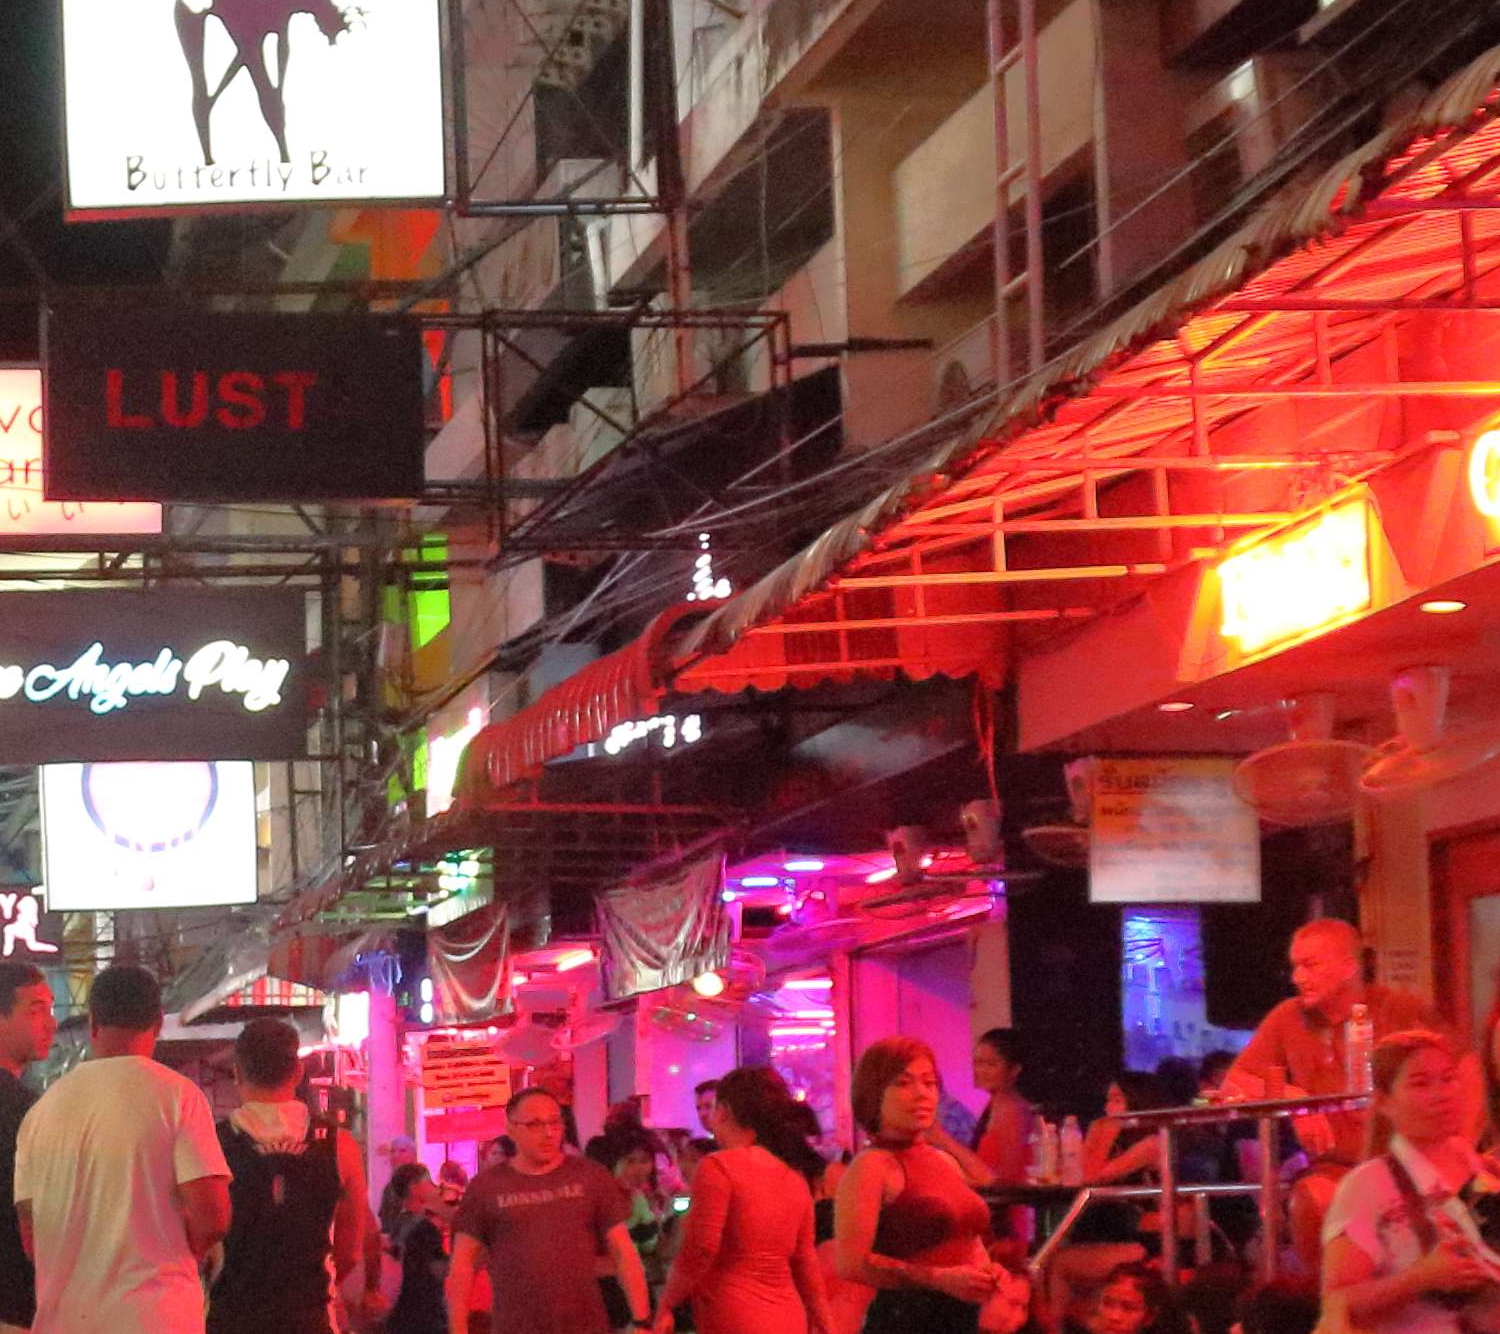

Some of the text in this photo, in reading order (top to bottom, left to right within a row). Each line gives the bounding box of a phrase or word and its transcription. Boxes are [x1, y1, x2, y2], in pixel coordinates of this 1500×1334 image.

[127, 150, 369, 192] Butterfly Bar
[106, 368, 320, 433] LUST
[23, 642, 183, 715] Angels
[182, 640, 290, 712] Play
